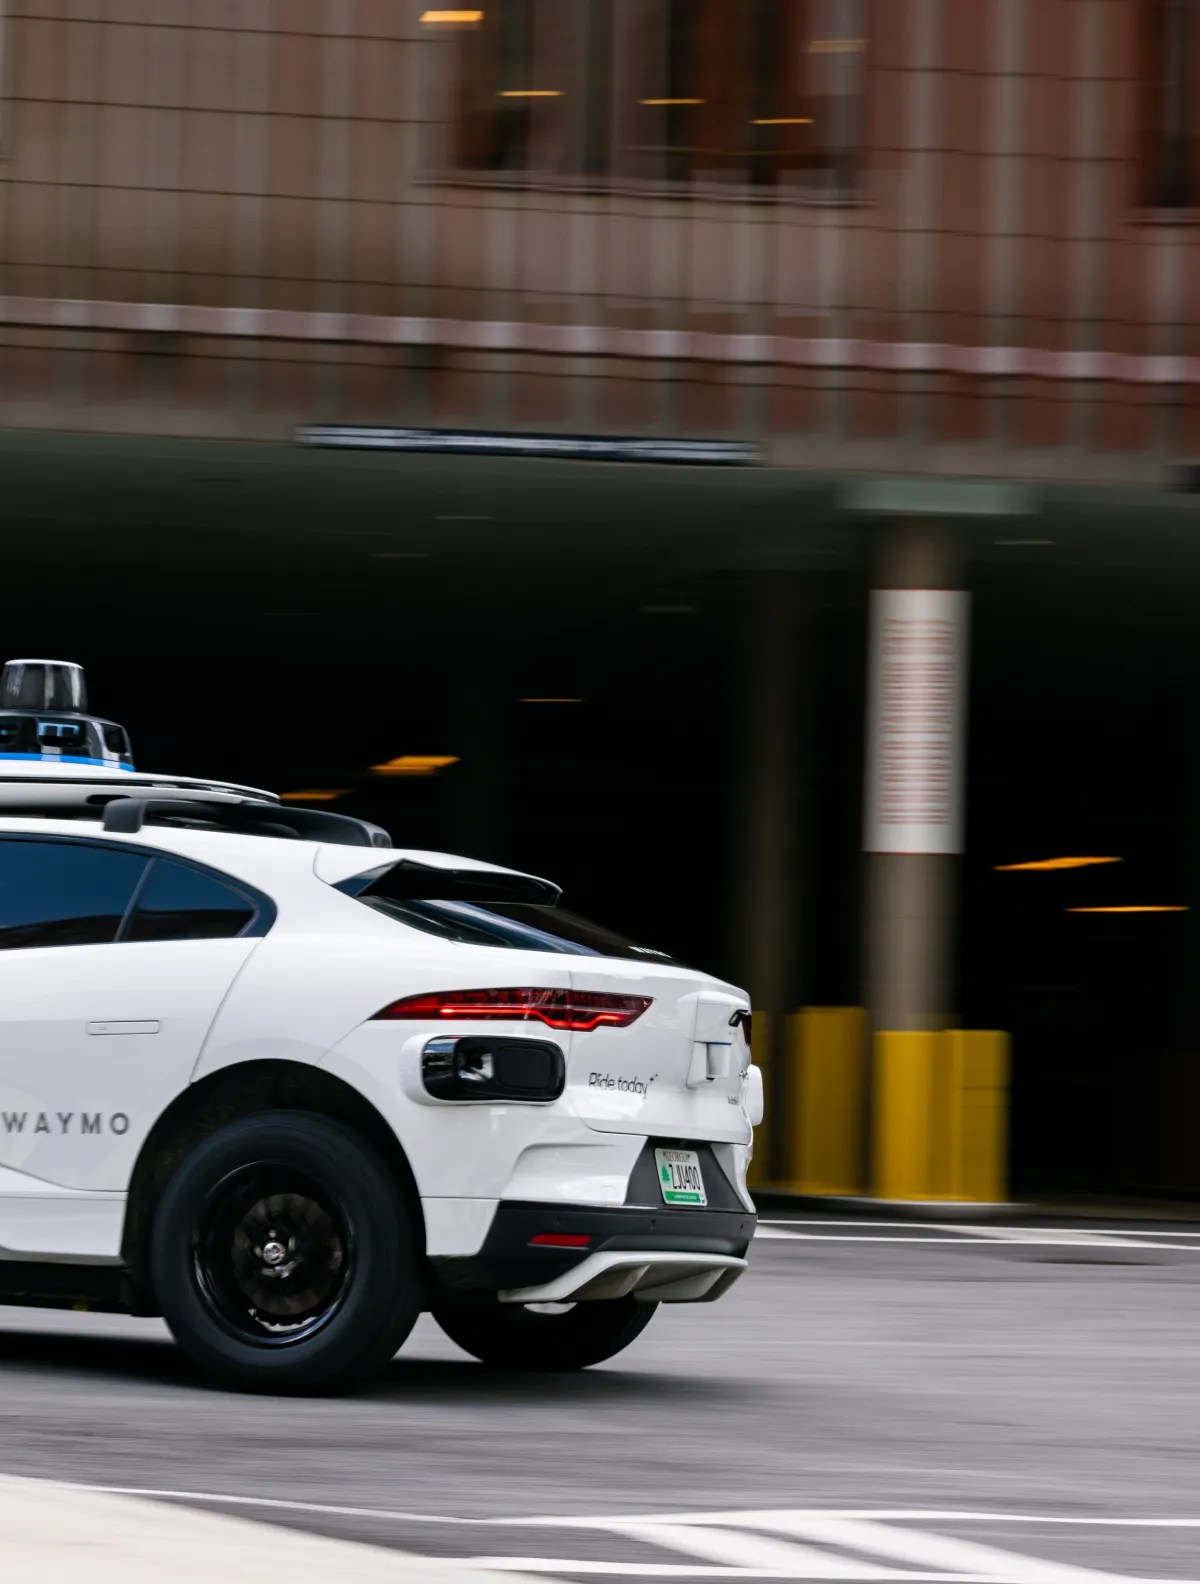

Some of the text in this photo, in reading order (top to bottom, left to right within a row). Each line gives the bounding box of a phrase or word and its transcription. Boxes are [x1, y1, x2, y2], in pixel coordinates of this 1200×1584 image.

[589, 1072, 648, 1100] Ride today
[1, 1111, 129, 1135] WAYMO
